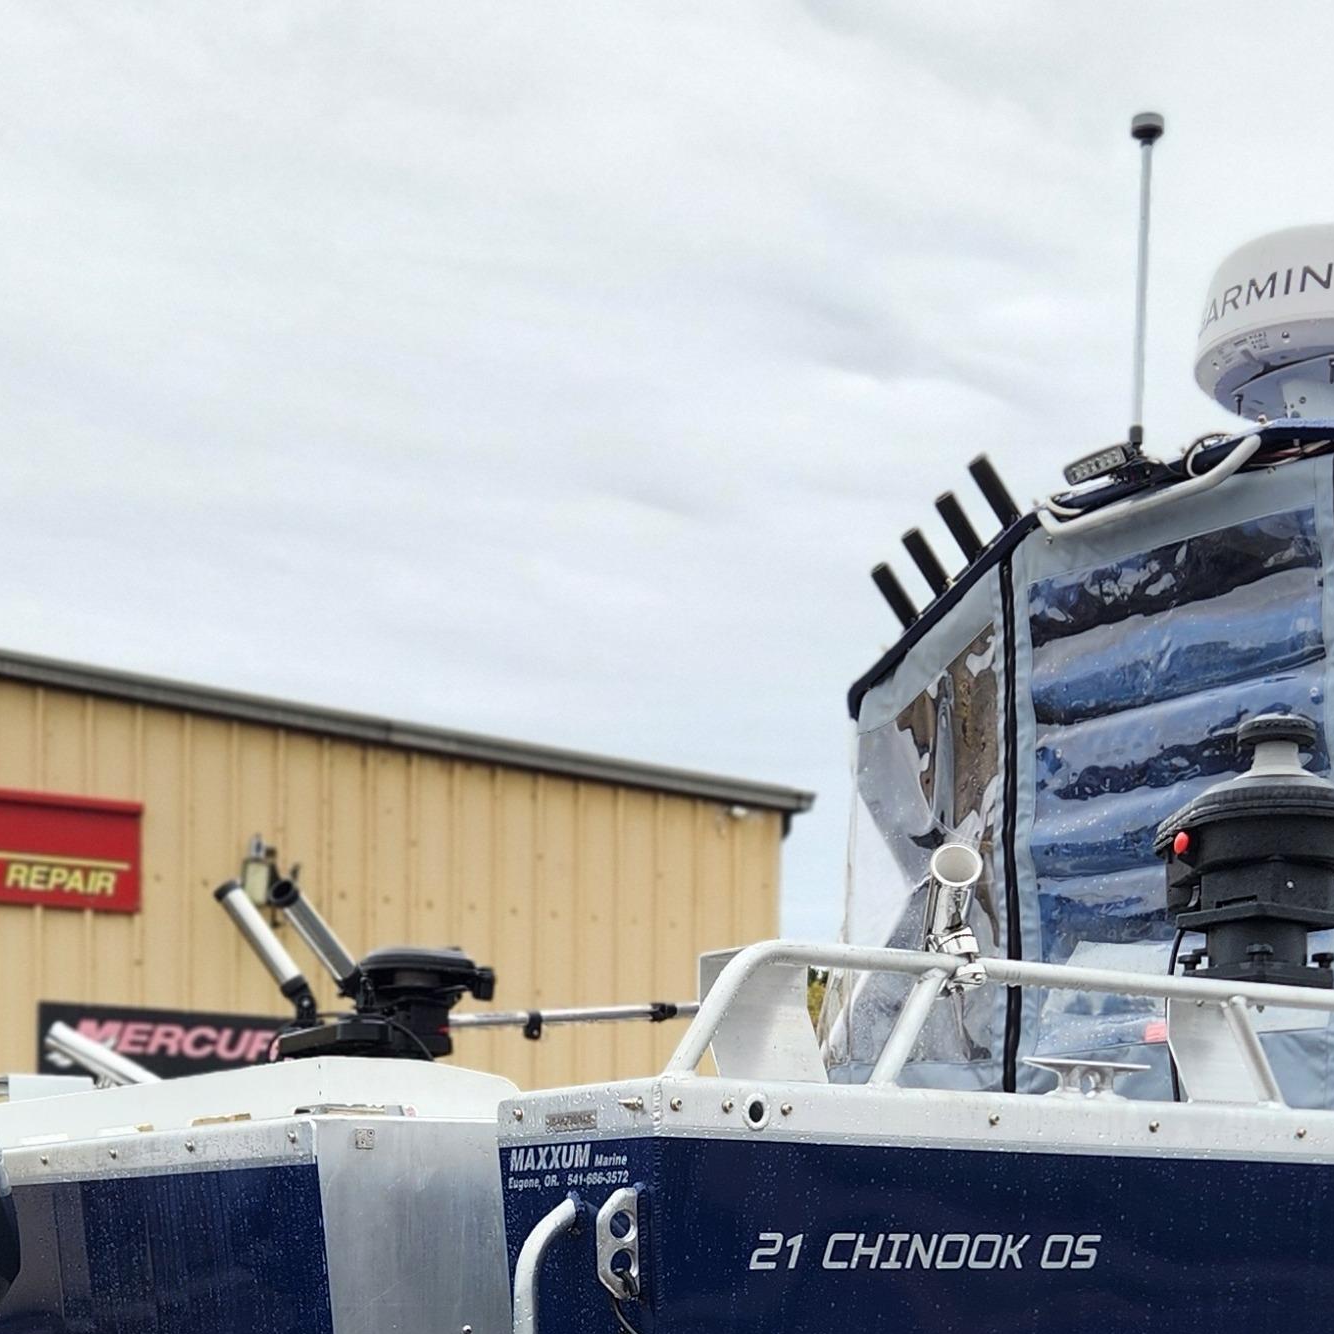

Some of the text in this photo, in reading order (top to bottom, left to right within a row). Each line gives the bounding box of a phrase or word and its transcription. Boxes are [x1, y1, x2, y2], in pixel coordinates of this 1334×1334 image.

[1200, 262, 1333, 333] ARMIN
[5, 862, 117, 896] REPAIR
[74, 1018, 293, 1062] MERCUR
[509, 1143, 627, 1172] MAXXUM Marine
[508, 1170, 629, 1191] Eugene, OR. 541-686-3572
[749, 1232, 1102, 1270] 21 CHINOOK OS
